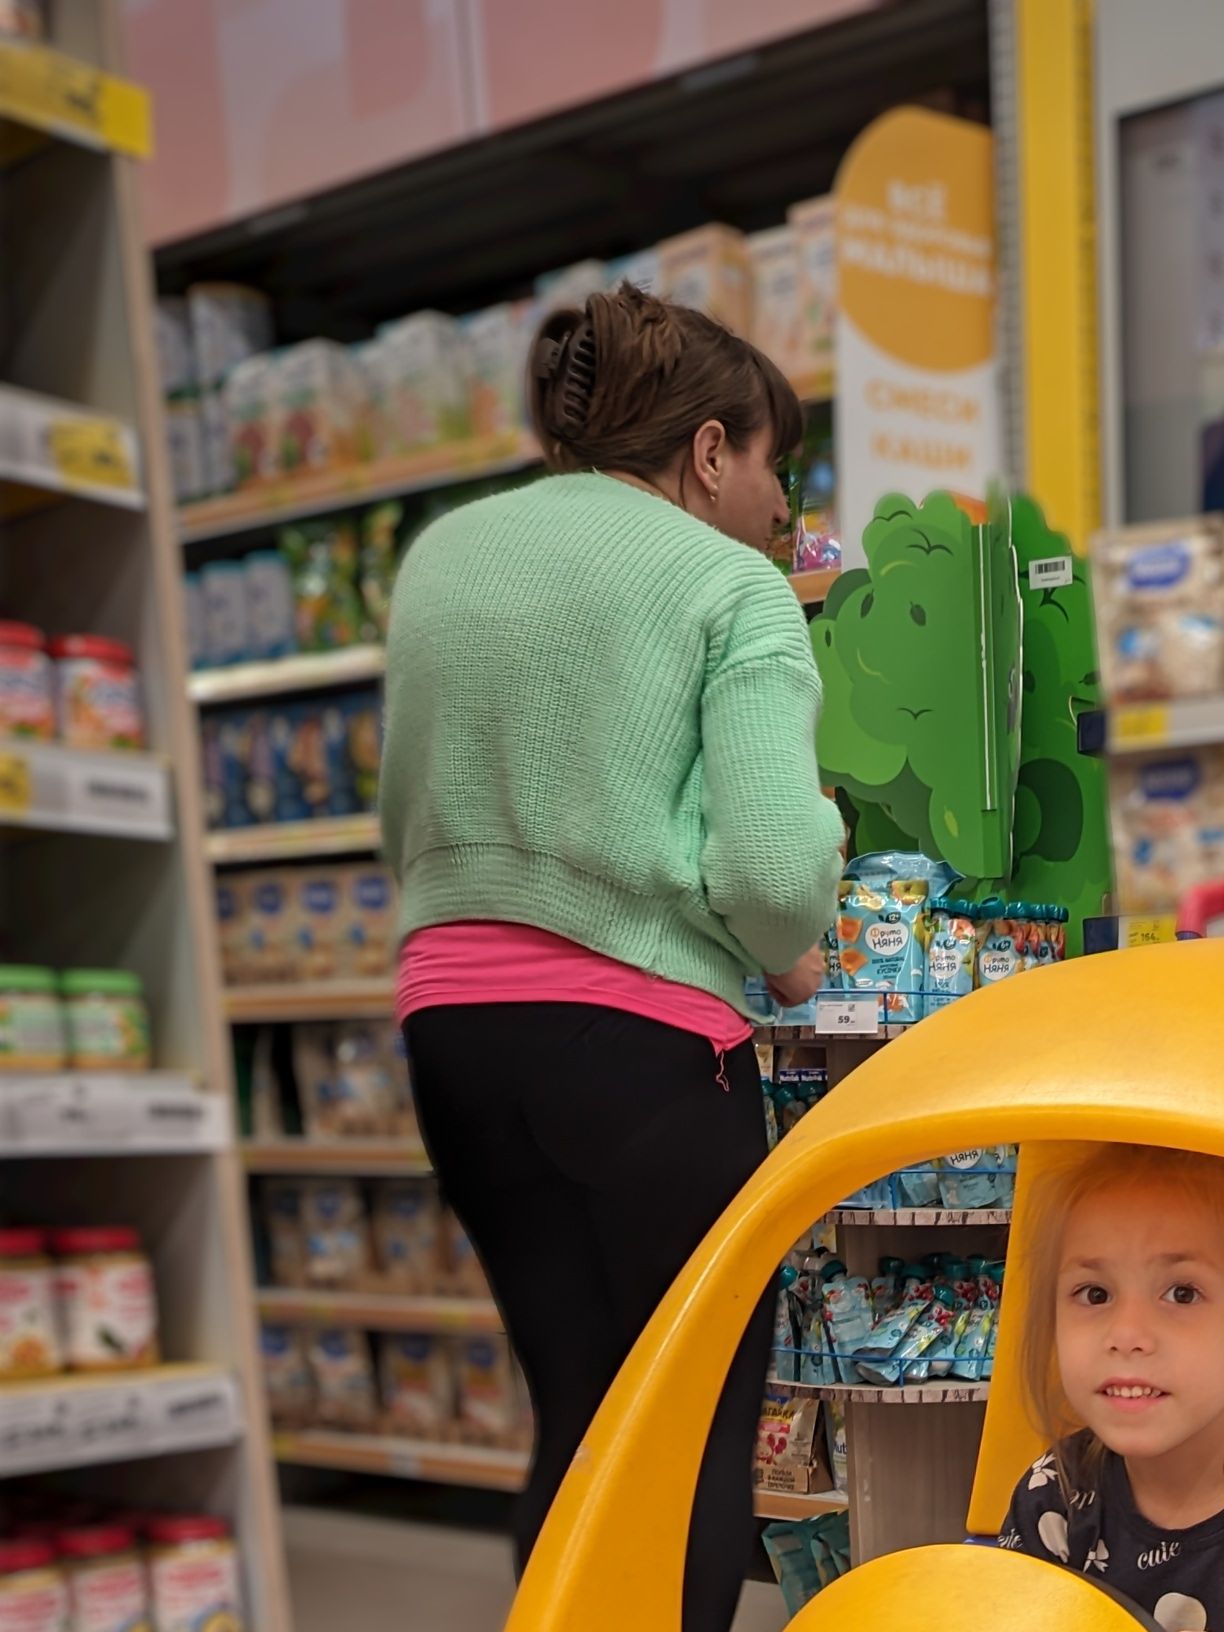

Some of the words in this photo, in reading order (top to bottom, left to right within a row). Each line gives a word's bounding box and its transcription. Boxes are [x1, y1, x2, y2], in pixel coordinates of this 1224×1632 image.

[864, 378, 978, 423] СМЕСИ
[873, 433, 972, 471] КАШИ
[837, 1015, 850, 1024] 59
[1137, 1540, 1181, 1571] cute
